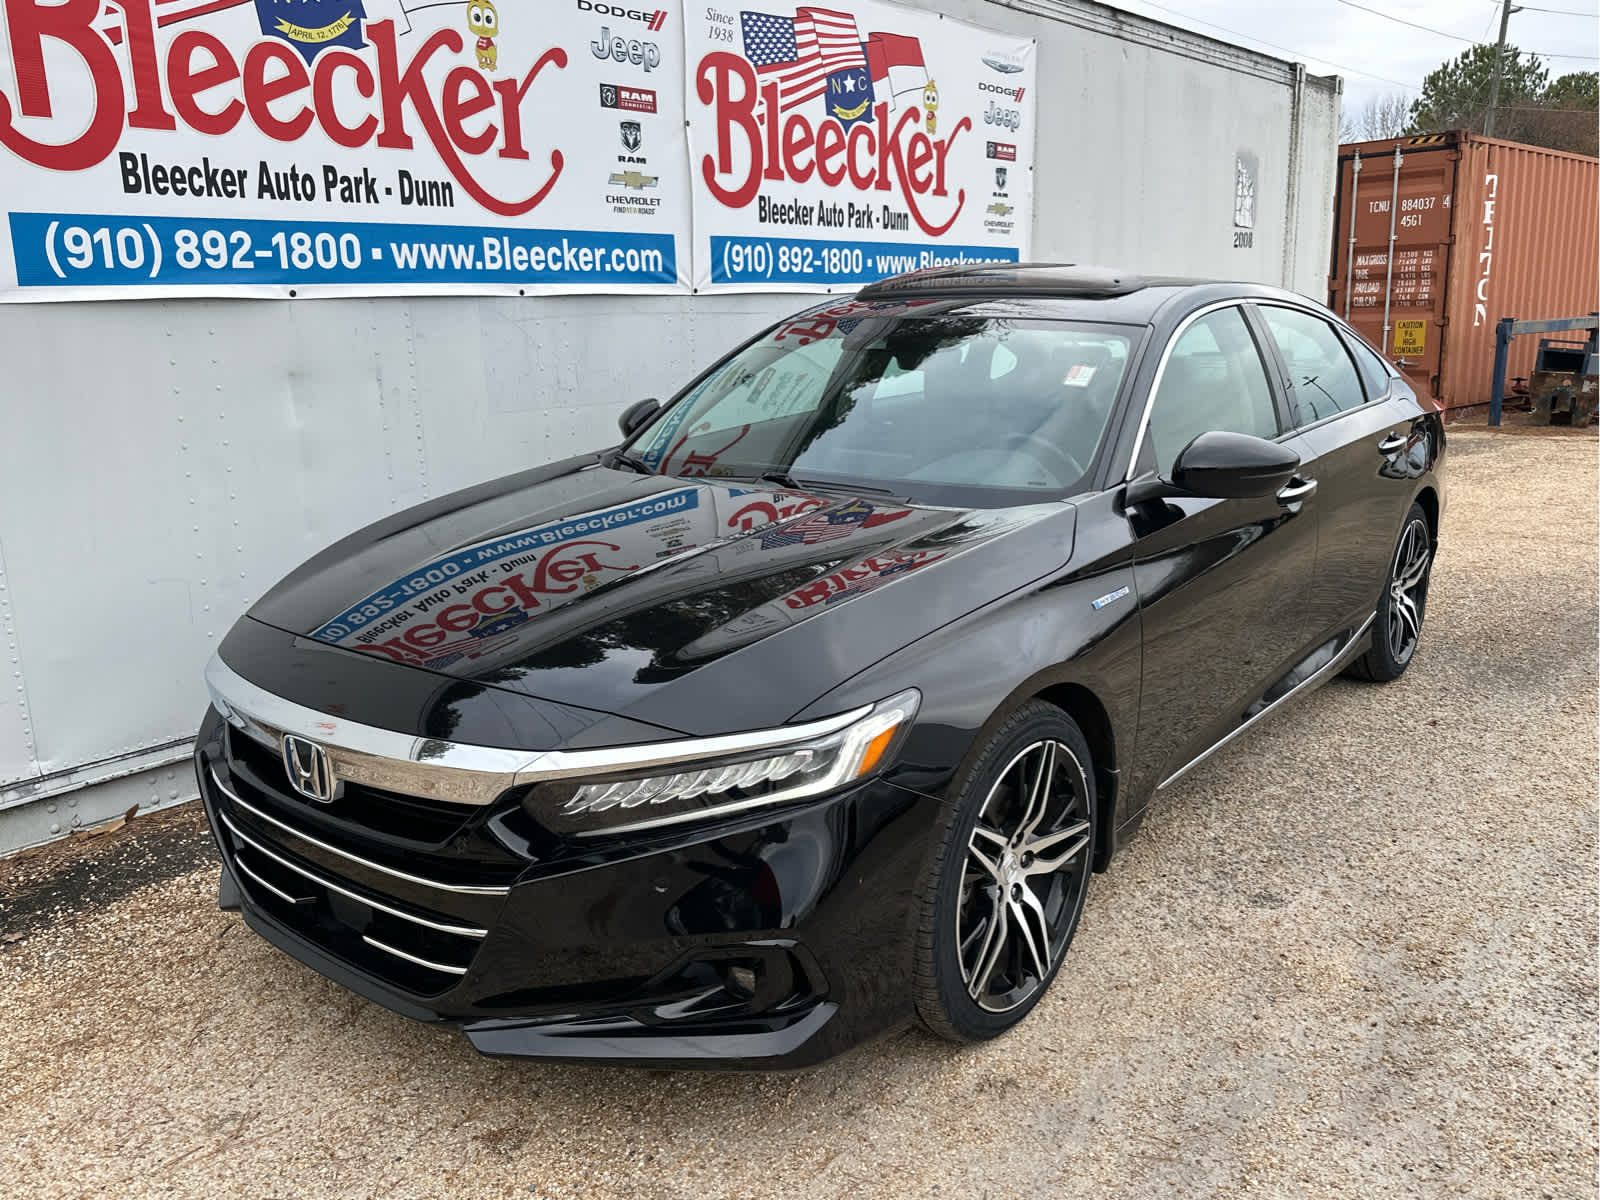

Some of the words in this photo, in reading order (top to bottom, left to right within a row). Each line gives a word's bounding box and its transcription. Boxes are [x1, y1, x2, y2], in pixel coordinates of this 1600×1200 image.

[577, 0, 656, 23] DODGE
[705, 8, 734, 25] Since
[291, 29, 314, 40] APRIL
[708, 26, 734, 42] 1938
[590, 26, 660, 72] Jeep
[831, 78, 841, 95] N
[978, 82, 1018, 97] DODGE
[620, 90, 653, 102] RAM
[0, 0, 567, 217] Bleecker
[984, 100, 1020, 132] Jeep
[696, 51, 972, 237] Bleecker
[996, 145, 1015, 154] RAM
[617, 155, 647, 164] RAM
[119, 151, 247, 199] Bleecker
[257, 160, 315, 201] Auto
[322, 164, 379, 204] Park
[398, 169, 454, 207] Dunn
[606, 195, 661, 206] CHEVROLET
[1368, 199, 1390, 213] TCNU
[1401, 196, 1435, 211] 884037
[758, 195, 814, 225] Bleecker
[817, 200, 844, 227] Auto
[847, 202, 873, 229] Park
[883, 205, 909, 231] Dunn
[1400, 214, 1423, 227] 45G1
[984, 220, 1014, 228] CHEVROLET
[45, 221, 163, 279] (910)
[174, 229, 362, 270] 892-1800
[390, 236, 663, 273] www.Bleecker.com
[723, 241, 774, 279] (910)
[778, 246, 862, 274] 892-1800
